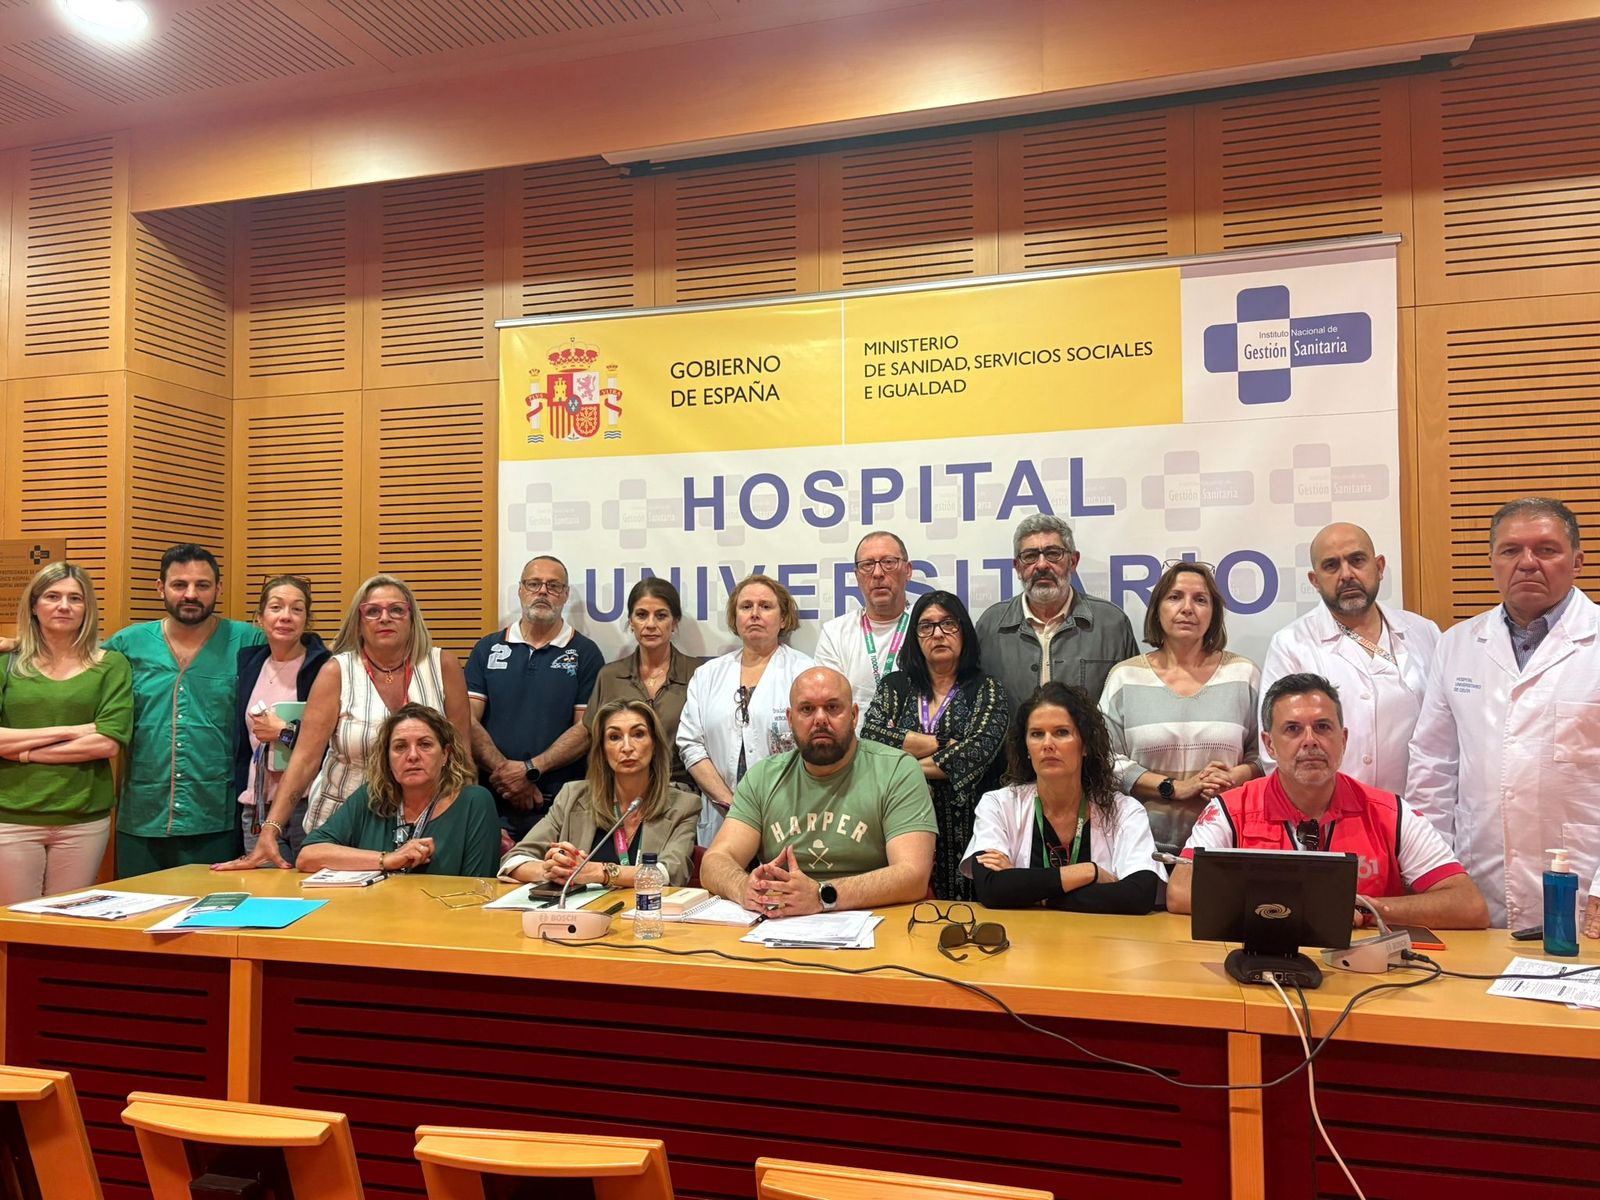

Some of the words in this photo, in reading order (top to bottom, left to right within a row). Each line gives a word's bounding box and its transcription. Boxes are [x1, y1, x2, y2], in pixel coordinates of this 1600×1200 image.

[1258, 329, 1289, 339] Instituto
[1291, 326, 1326, 337] Nacional
[1327, 325, 1338, 334] de
[864, 335, 959, 356] MINISTERIO
[1244, 342, 1287, 360] Gestión
[1294, 336, 1348, 357] Sanitaria
[670, 355, 781, 379] GOBIERNO
[864, 363, 886, 378] DE
[891, 356, 970, 376] SANIDAD,
[974, 348, 1062, 369] SERVICIOS
[1066, 341, 1153, 362] SOCIALES
[671, 389, 697, 408] DE
[703, 380, 781, 406] ESPAÑA
[864, 386, 873, 400] E
[878, 379, 967, 399] IGUALDAD
[683, 456, 1116, 532] HOSPITAL
[585, 549, 1279, 623] UIVERITRO
[486, 643, 513, 670] 2
[770, 811, 868, 843] HARPER
[550, 914, 577, 922] BOSCH
